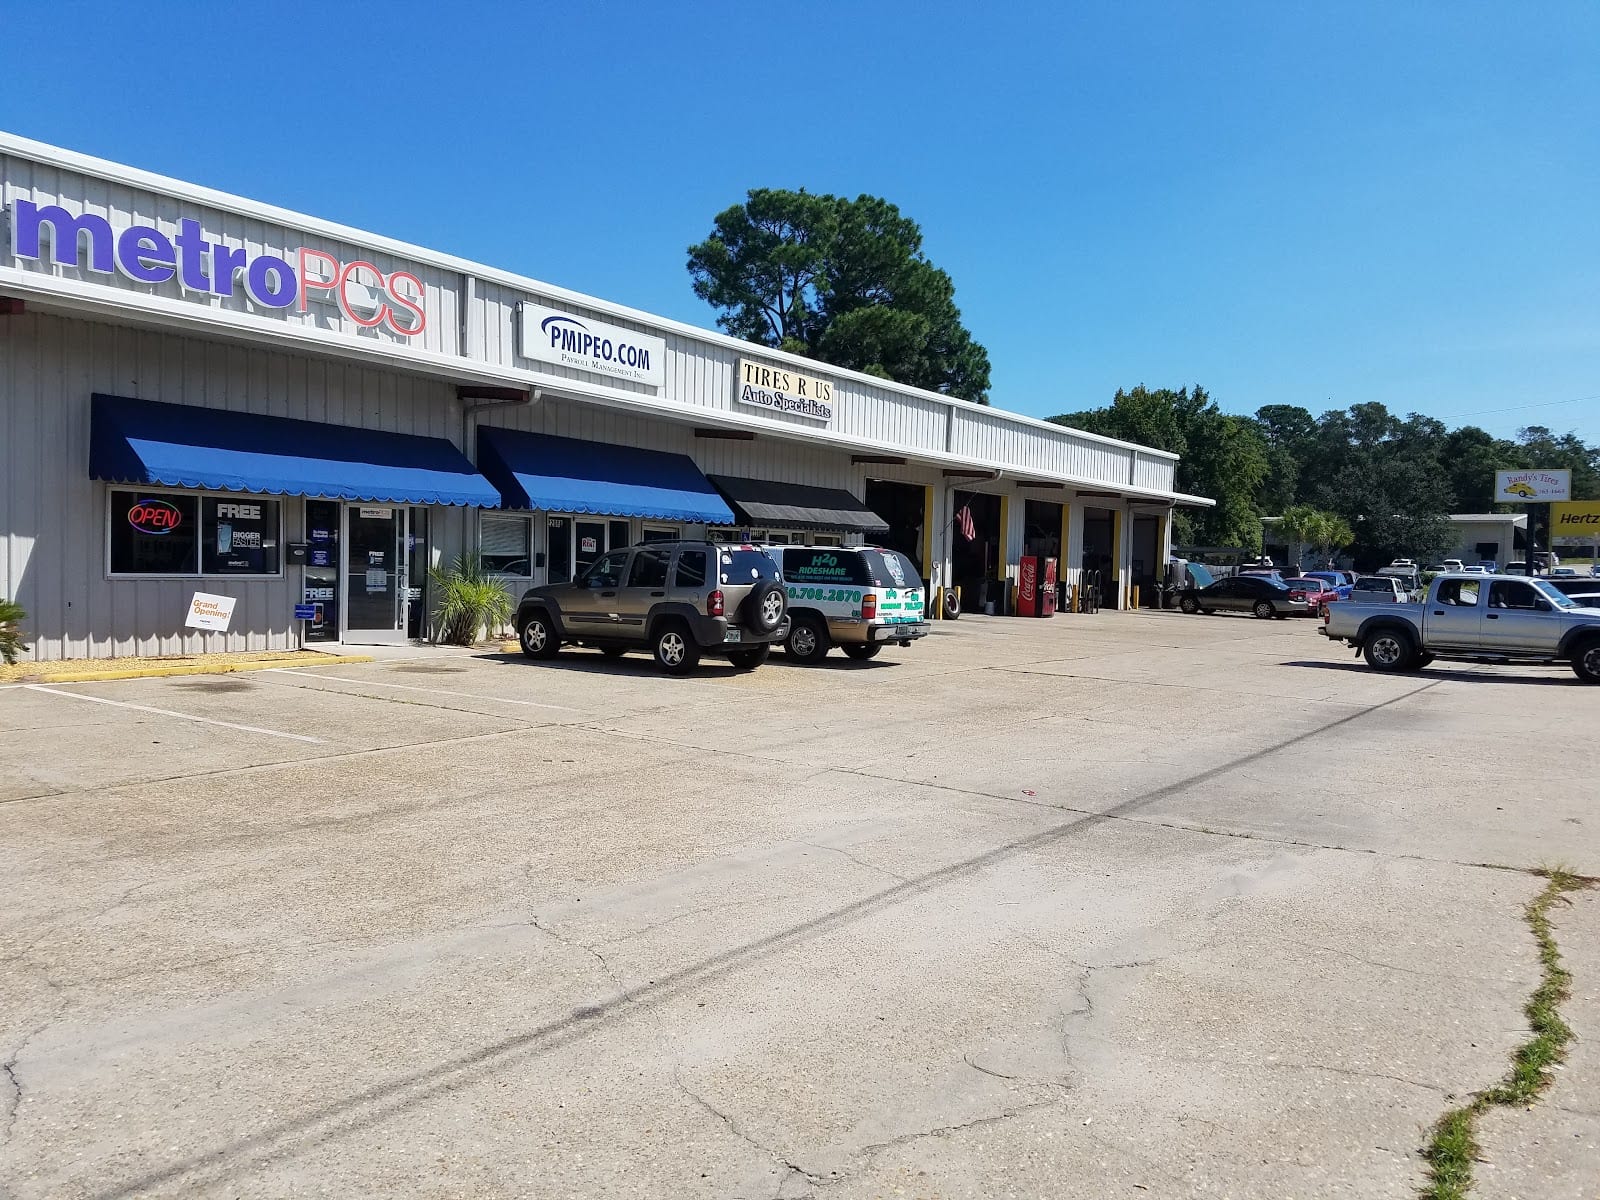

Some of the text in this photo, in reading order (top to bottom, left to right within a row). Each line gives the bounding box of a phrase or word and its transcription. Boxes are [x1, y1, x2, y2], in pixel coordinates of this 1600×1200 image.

[11, 198, 427, 337] metroPCS
[551, 325, 650, 371] PMIPEO.COM
[744, 363, 831, 401] TIRES R US
[741, 384, 831, 419] Auto Specialists
[1539, 473, 1560, 486] Tires
[130, 506, 177, 527] OPEN
[217, 503, 261, 520] FREE
[1560, 513, 1600, 524] Hertz
[232, 531, 261, 540] BIGGER
[798, 566, 847, 576] RIDESHARE
[193, 599, 219, 610] Grand
[194, 606, 231, 620] Opening!
